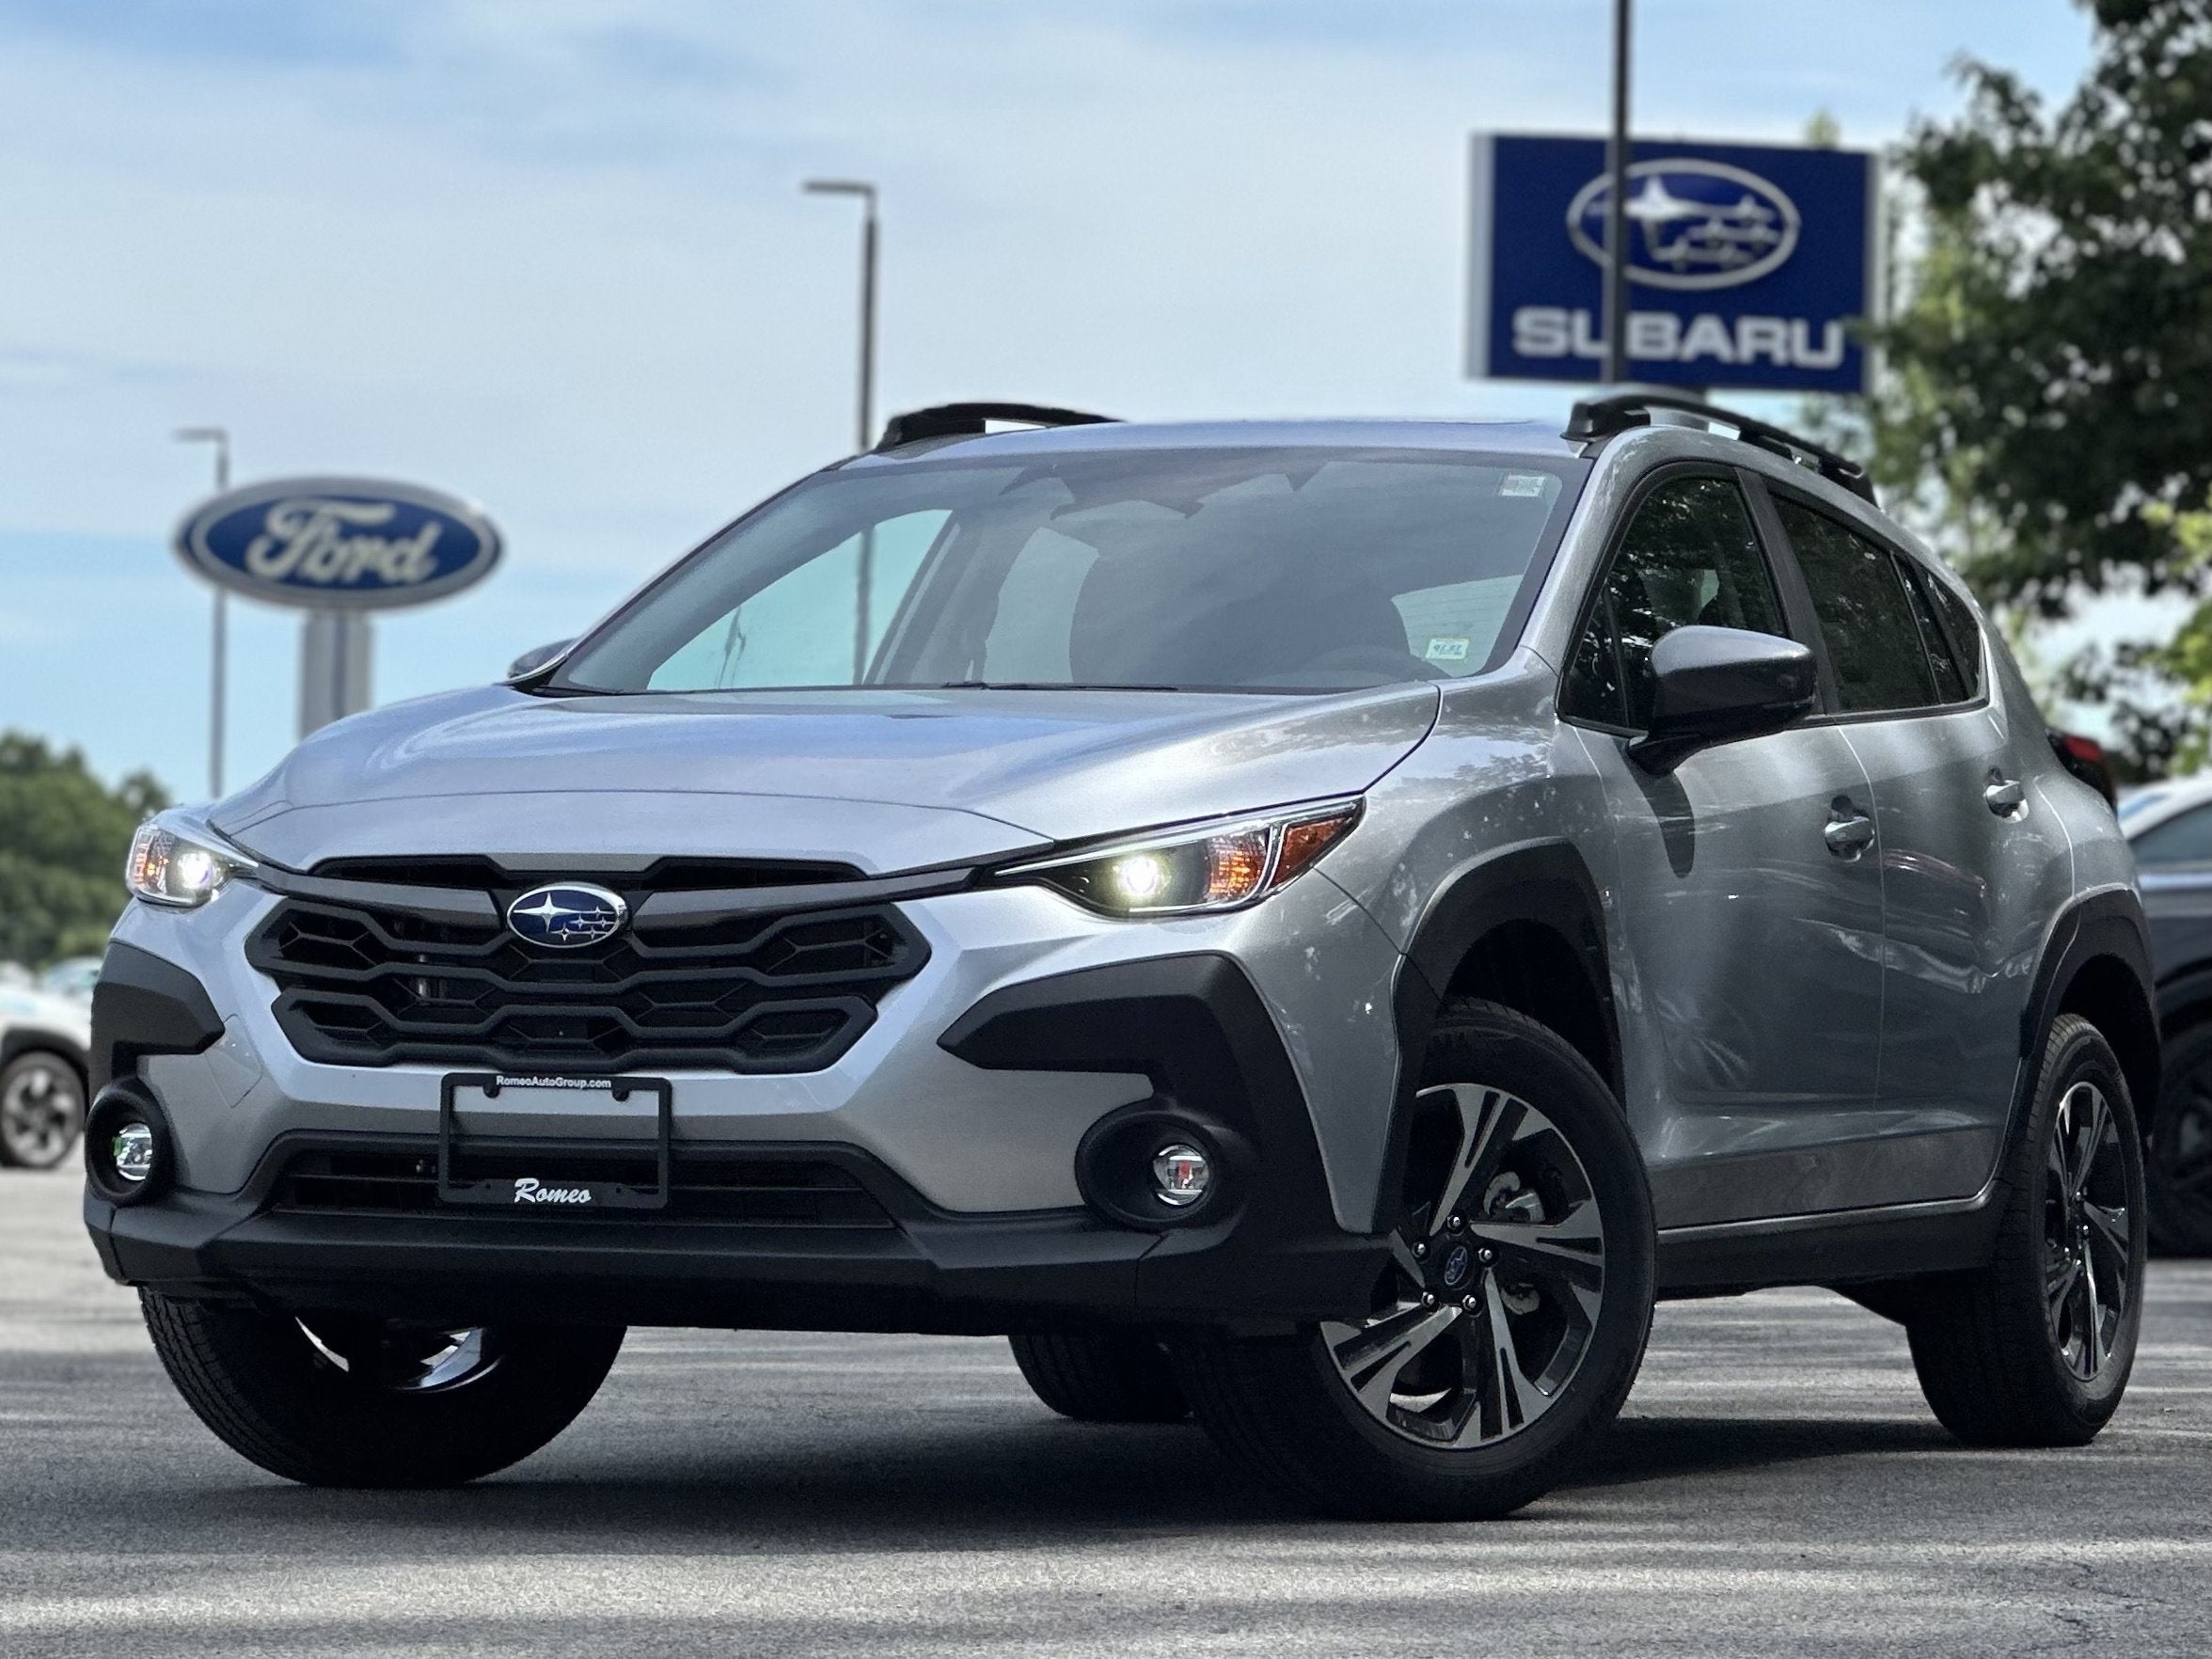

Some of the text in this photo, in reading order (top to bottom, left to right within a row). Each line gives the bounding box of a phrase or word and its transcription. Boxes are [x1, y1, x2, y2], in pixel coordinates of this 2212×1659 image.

[245, 498, 443, 582] Ford
[496, 1075, 611, 1089] RomeoAutoGroup.com
[514, 1177, 592, 1203] Romeo
